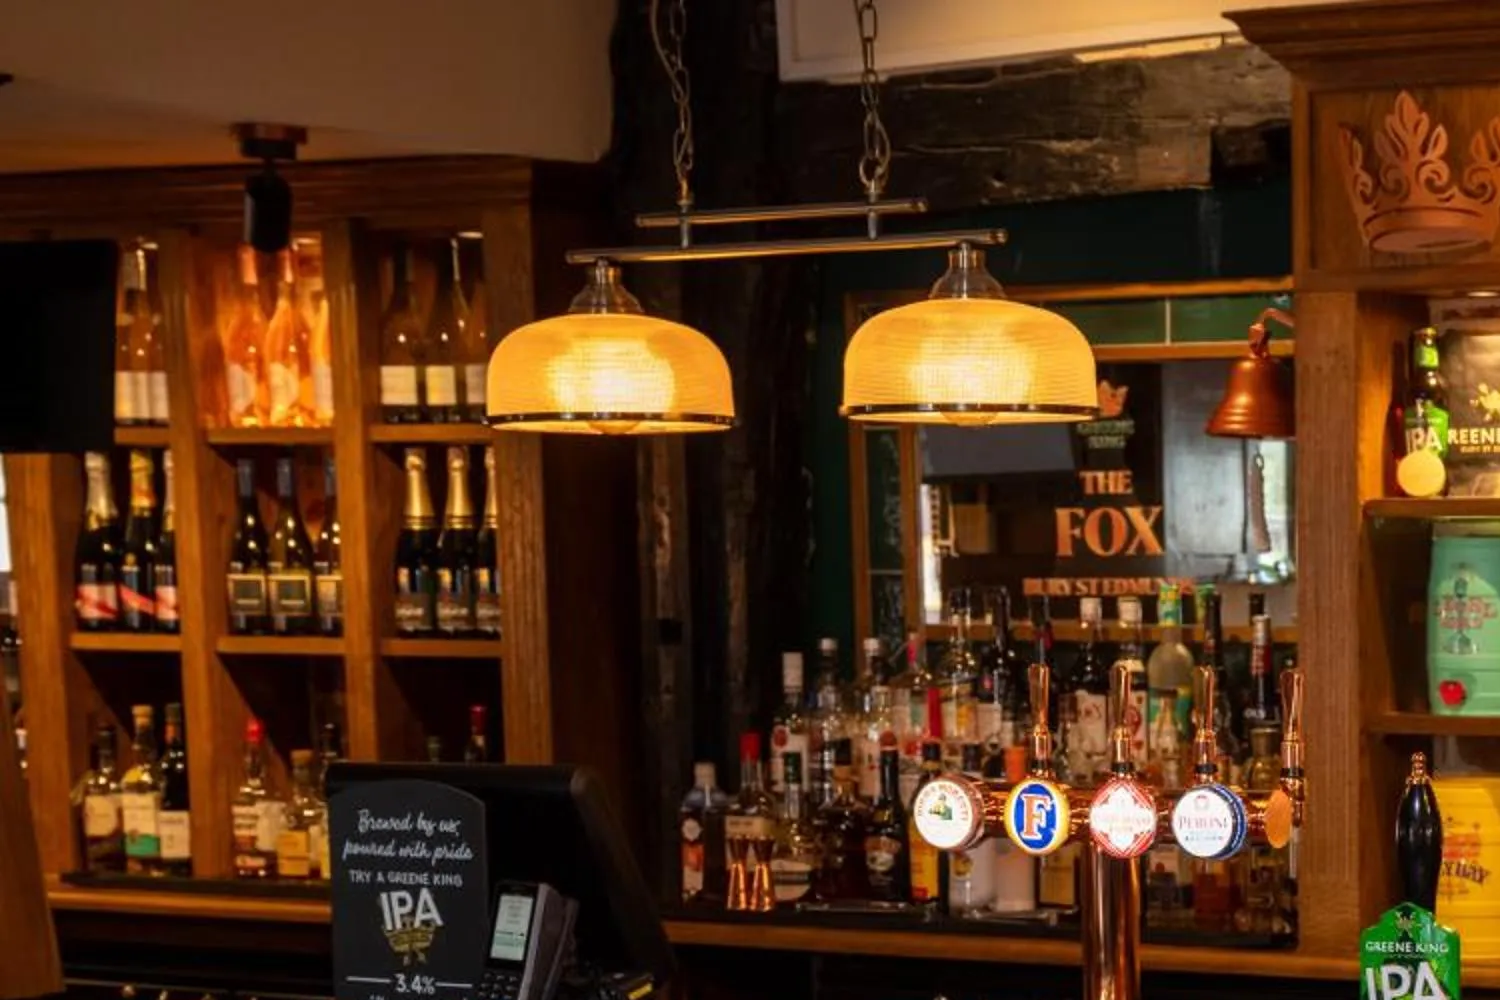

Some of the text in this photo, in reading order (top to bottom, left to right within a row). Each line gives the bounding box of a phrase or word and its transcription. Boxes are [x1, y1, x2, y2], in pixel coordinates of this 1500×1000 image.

[1405, 426, 1443, 453] IPA
[1079, 470, 1133, 495] THE
[1055, 506, 1166, 557] FOX
[357, 808, 413, 833] Brewed
[416, 811, 437, 837] by
[1020, 794, 1051, 840] F
[342, 838, 396, 861] poured
[399, 840, 432, 858] with
[349, 869, 463, 887] TRY A GREENE KING
[379, 888, 444, 931] IPA
[1365, 941, 1449, 953] GREENE KING
[394, 973, 435, 995] 3.4%
